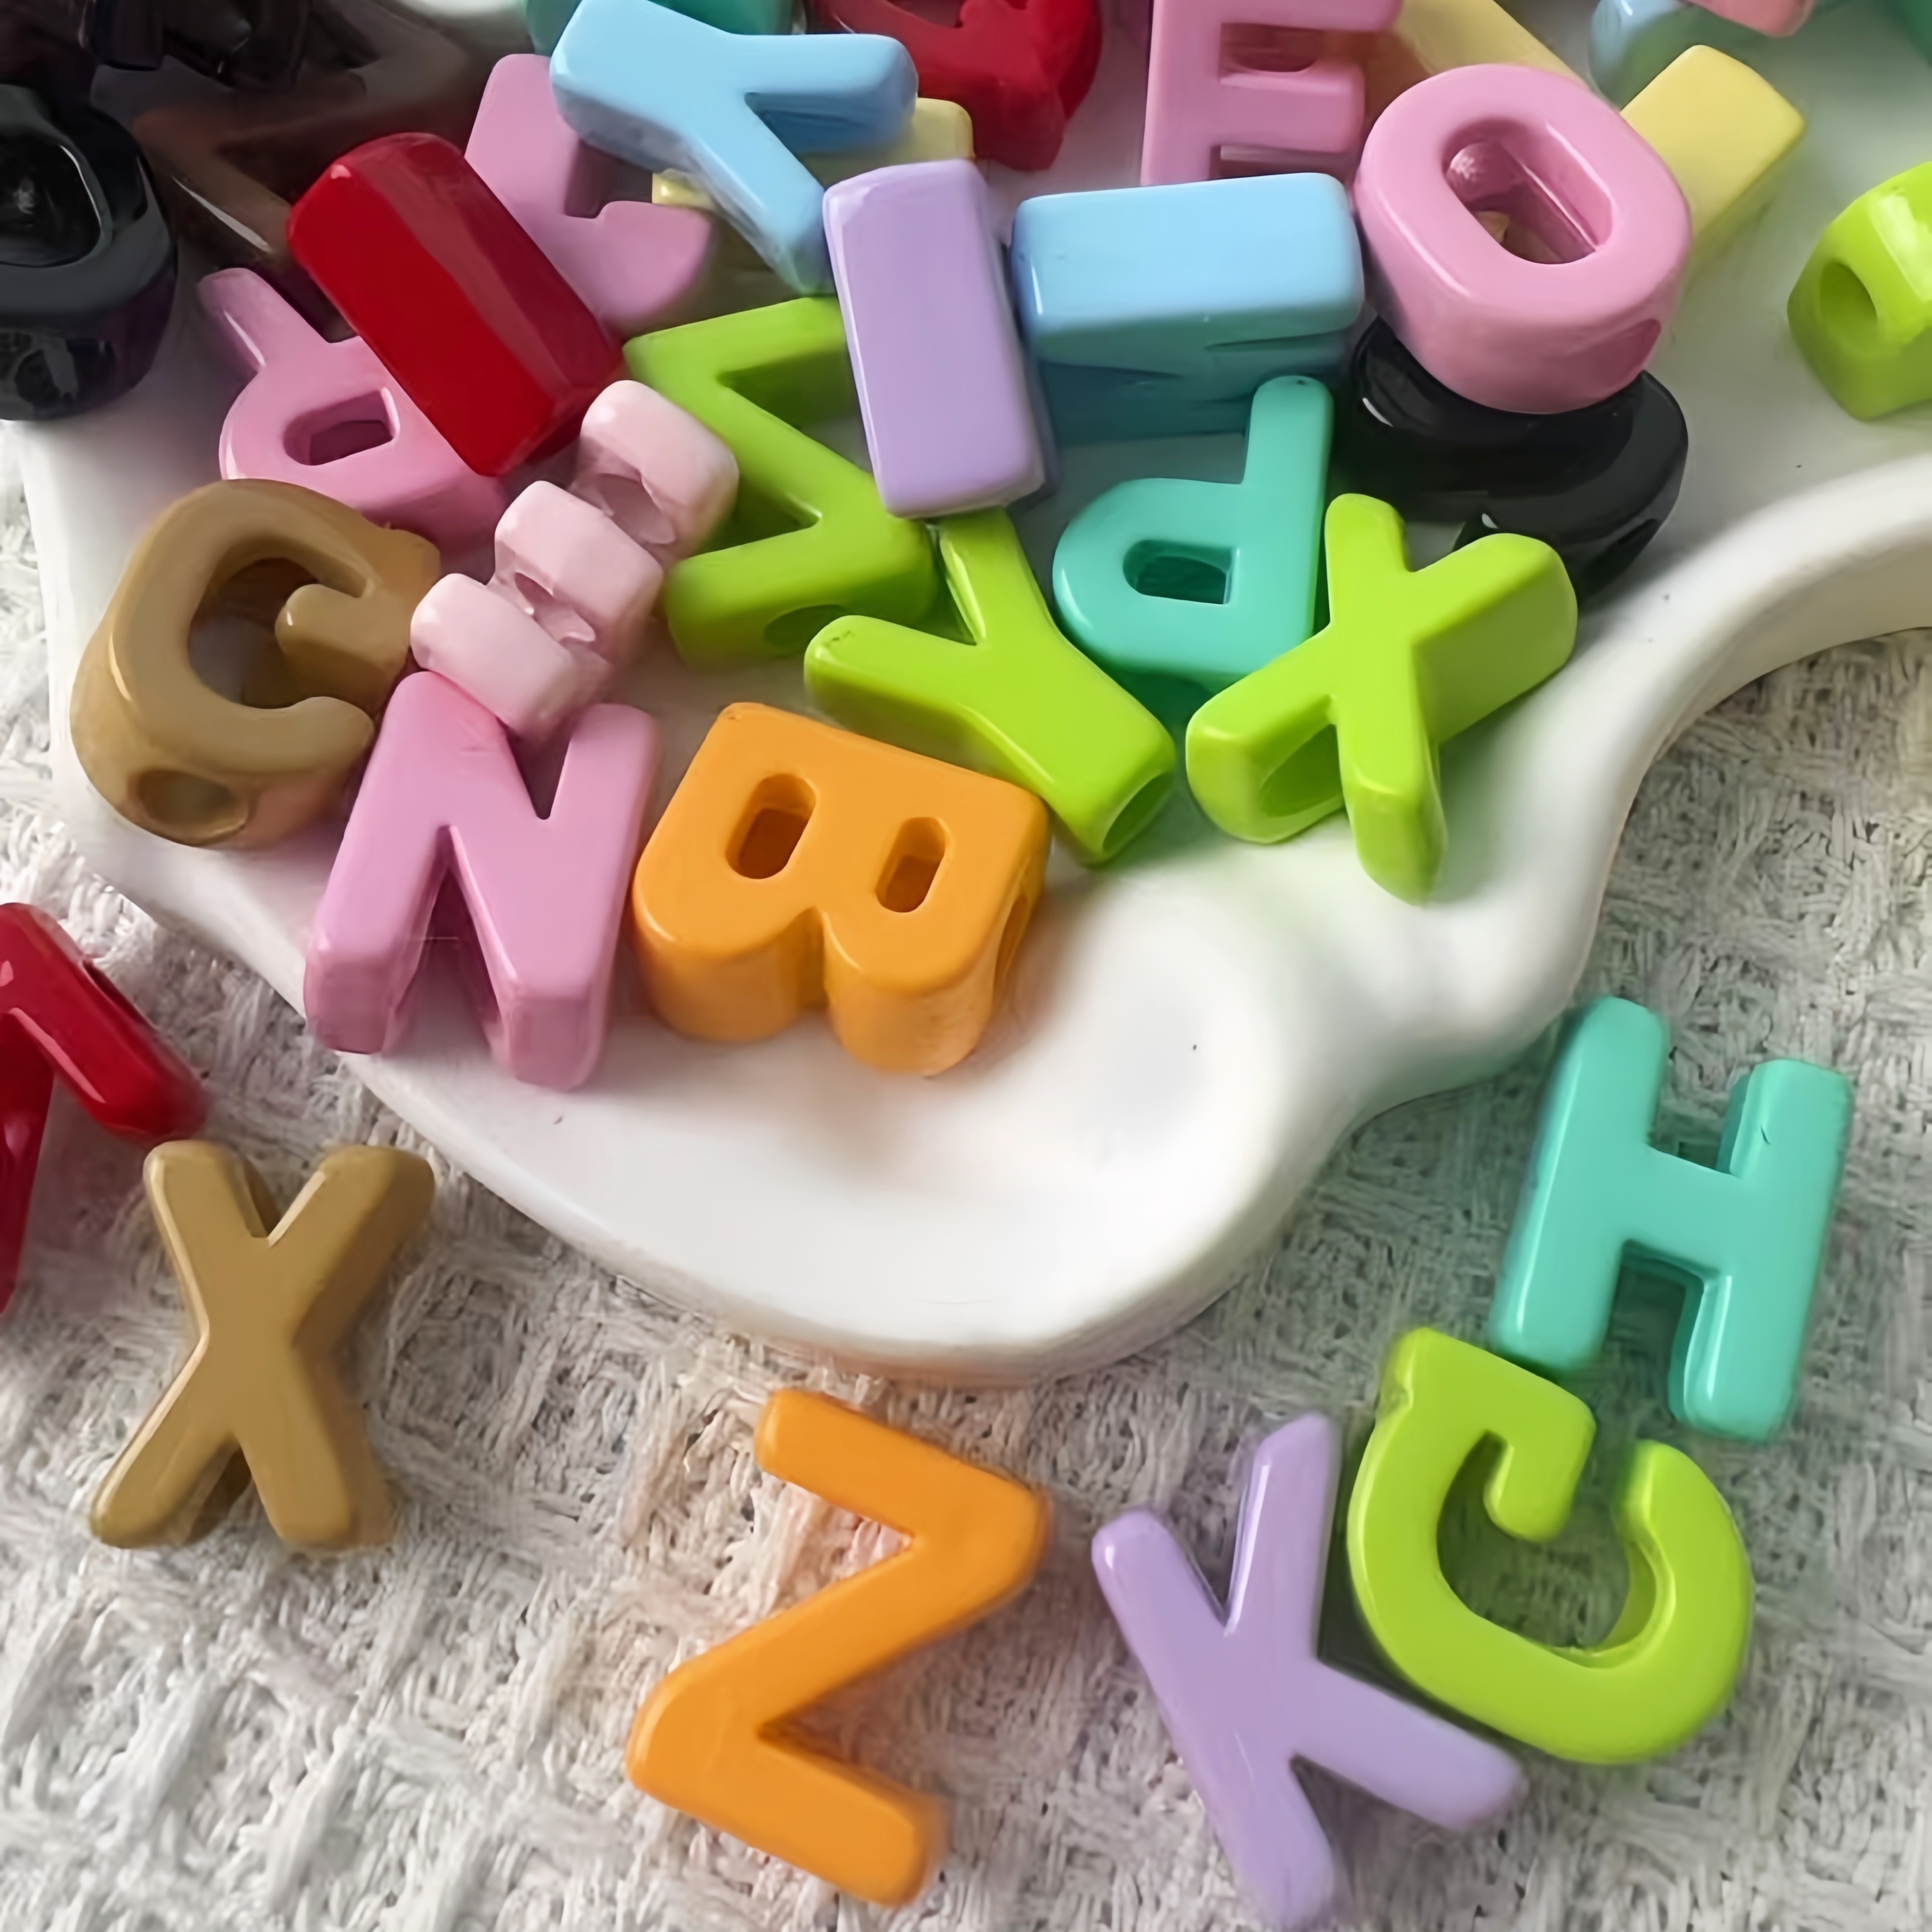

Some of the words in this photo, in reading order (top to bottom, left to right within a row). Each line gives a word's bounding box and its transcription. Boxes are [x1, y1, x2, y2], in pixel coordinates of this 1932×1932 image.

[304, 671, 661, 1091] N
[632, 702, 1051, 1076] B
[804, 508, 1175, 868] Y
[1186, 493, 1578, 904] X
[90, 1139, 436, 1551] X
[1489, 996, 1853, 1441] H
[1091, 1413, 1528, 1928] K
